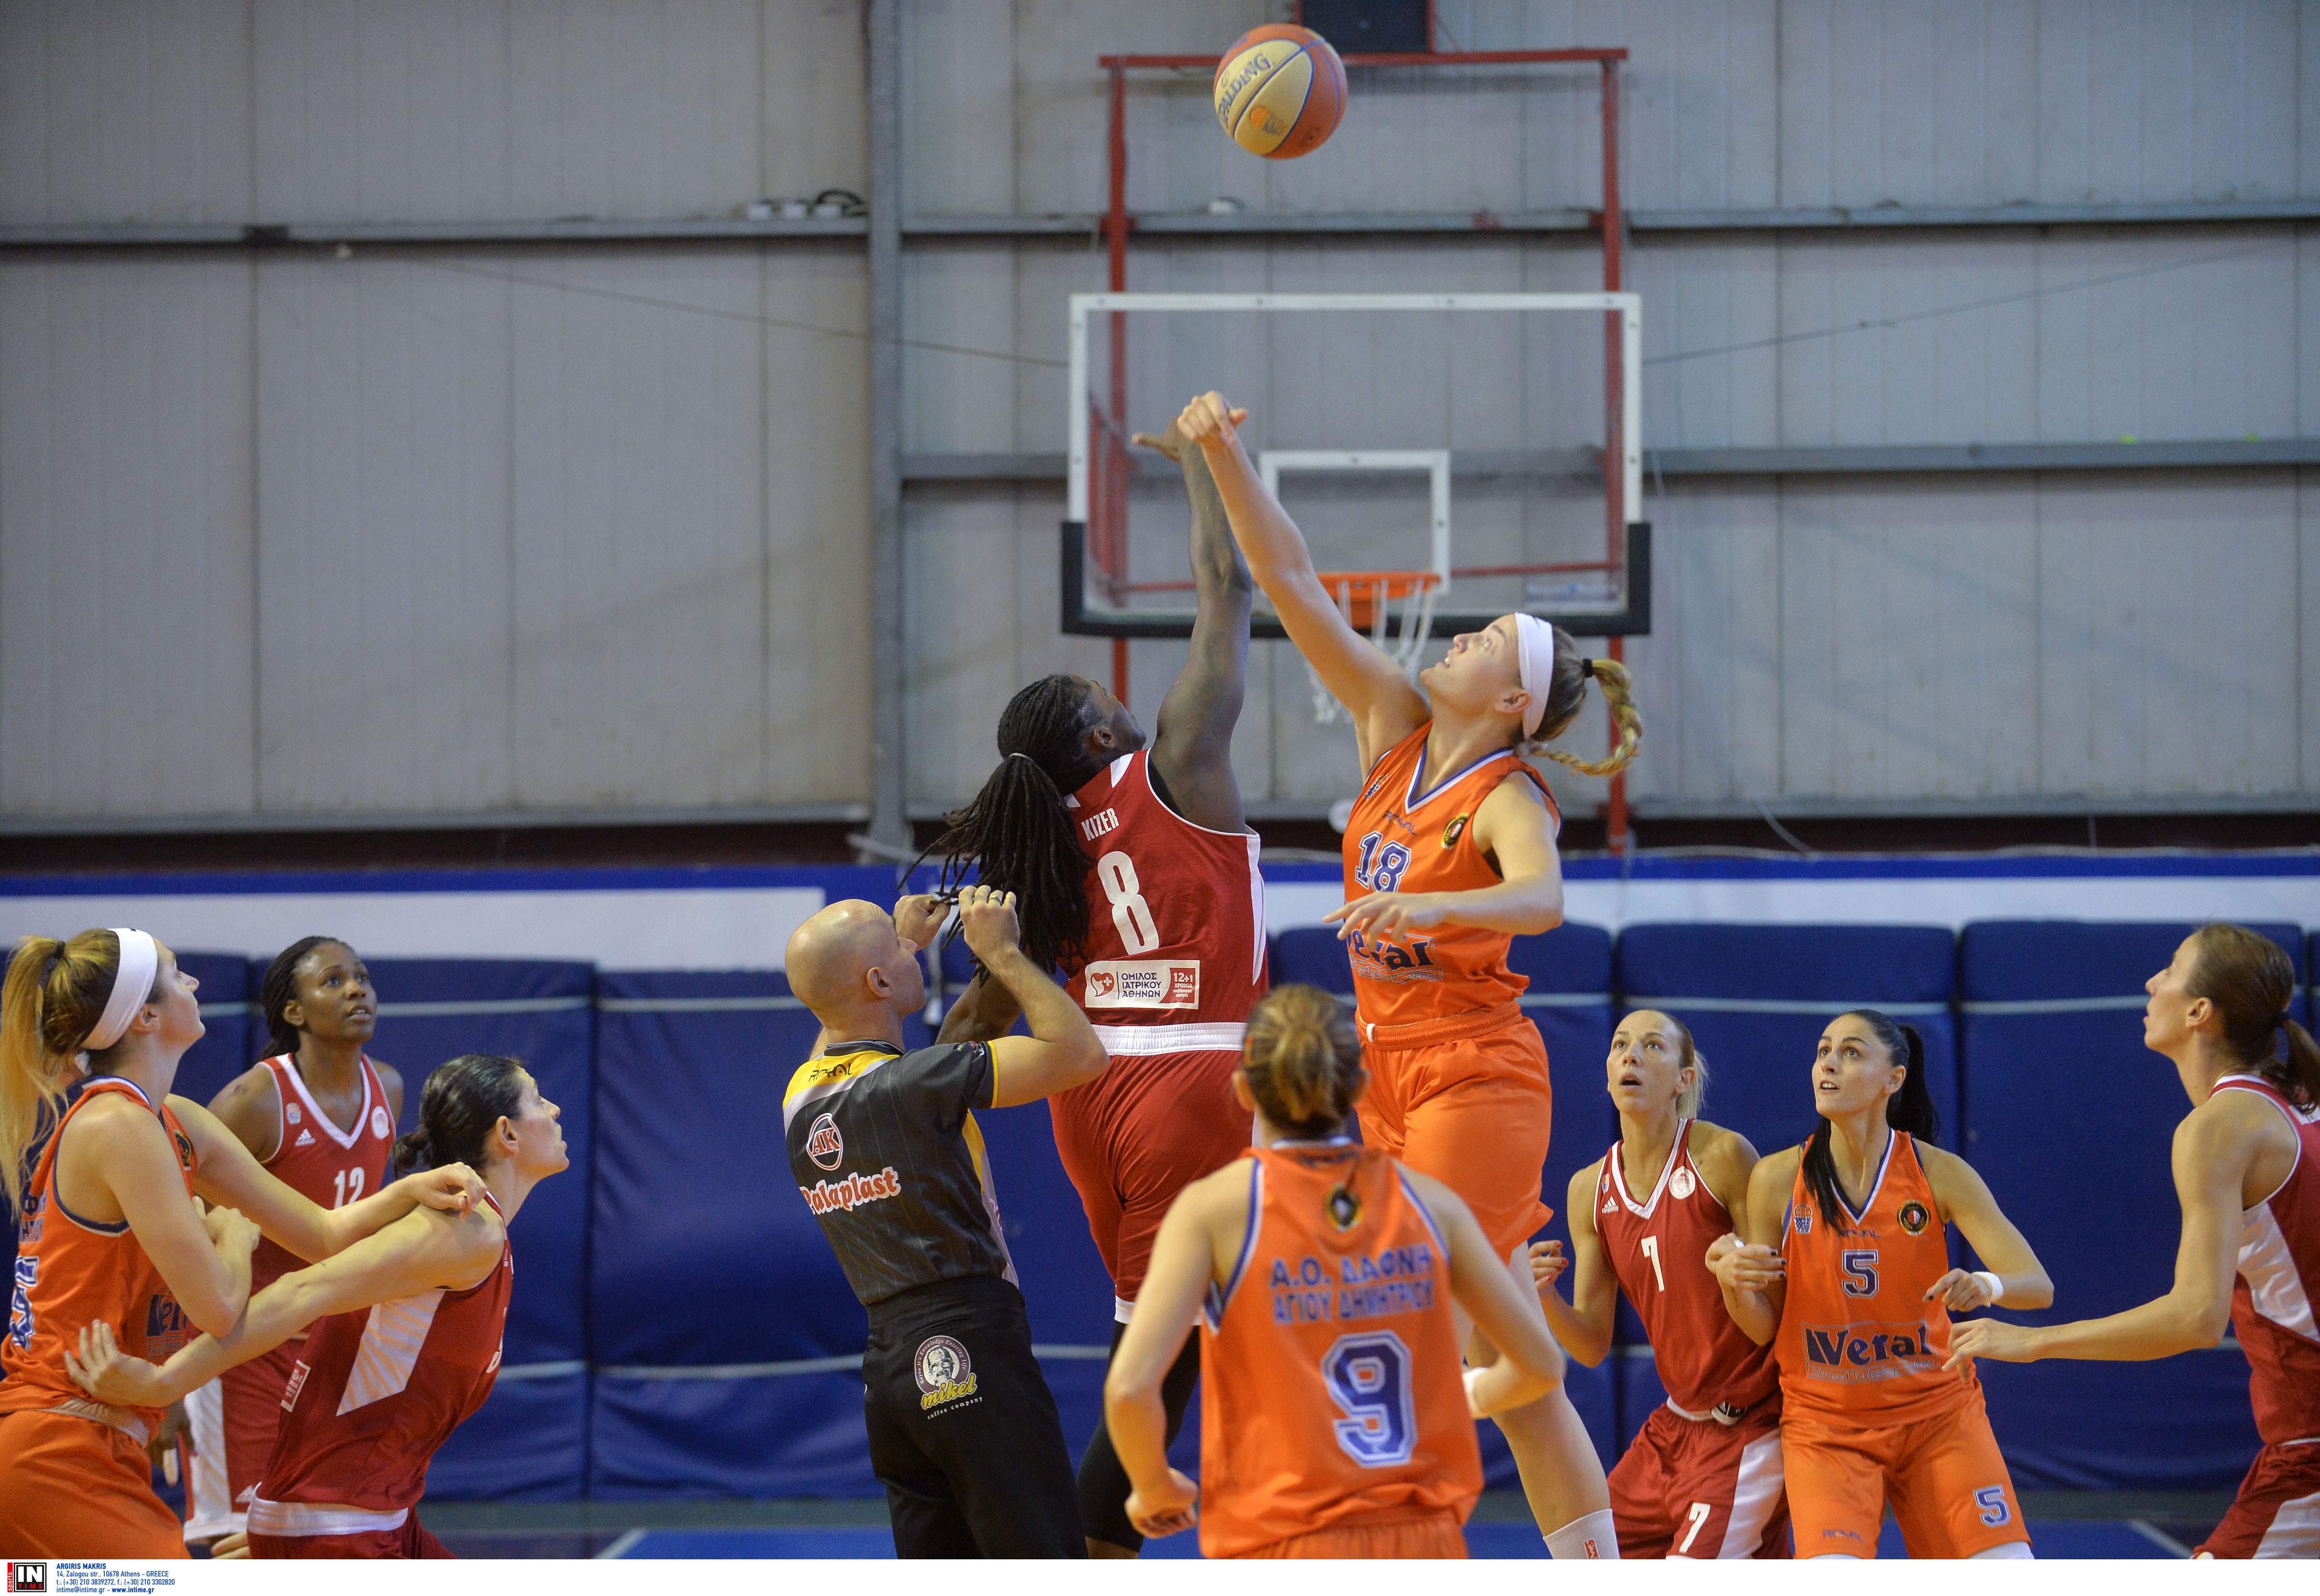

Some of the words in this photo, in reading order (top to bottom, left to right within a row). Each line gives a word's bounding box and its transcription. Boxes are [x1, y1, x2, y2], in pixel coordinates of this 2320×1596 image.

[1081, 808, 1119, 841] KIZER
[1355, 831, 1411, 893] 18
[1097, 851, 1159, 955] 8
[1173, 972, 1193, 983] 12+1
[812, 1128, 840, 1156] AK
[334, 1166, 364, 1209] 12
[1642, 1235, 1665, 1291] 7
[1842, 1250, 1878, 1297] 5
[919, 1339, 944, 1356] Knowledge
[945, 1339, 965, 1358] Entering
[1805, 1323, 1933, 1366] Veral
[921, 1373, 977, 1410] mikel
[928, 1408, 947, 1420] coffee
[951, 1396, 983, 1410] company
[1321, 1330, 1418, 1469] 9
[1973, 1485, 2010, 1527] 5
[1679, 1503, 1710, 1553] 7
